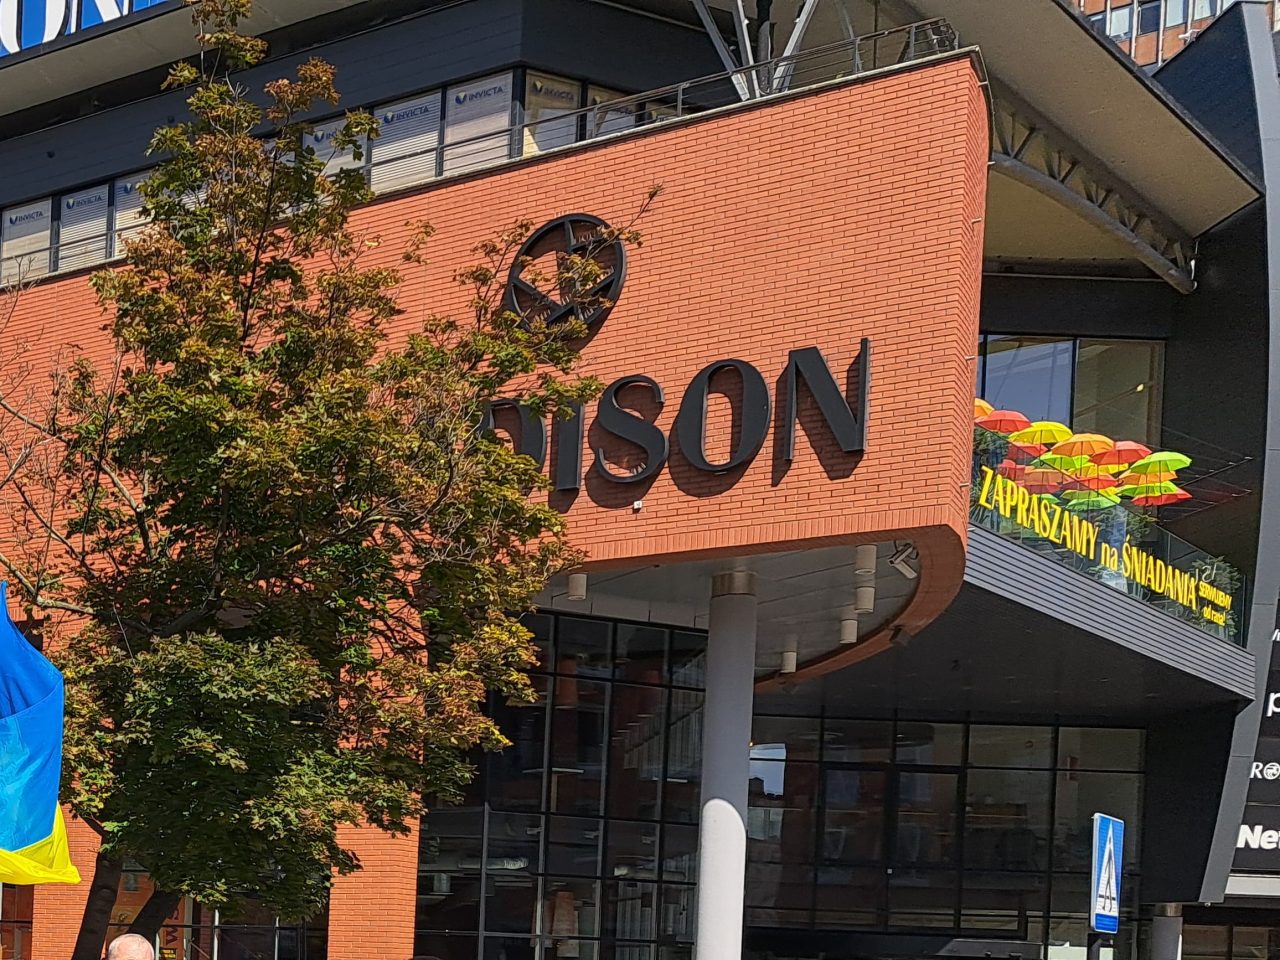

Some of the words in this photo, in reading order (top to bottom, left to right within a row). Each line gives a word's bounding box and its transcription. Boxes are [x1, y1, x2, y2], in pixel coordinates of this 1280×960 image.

[469, 86, 504, 102] INVICTA
[396, 105, 430, 121] INVICTA
[18, 210, 44, 224] INVICTA
[978, 465, 1099, 560] ZAPRASZAMY
[1100, 542, 1118, 571] na
[1121, 534, 1198, 611] ŚNIADANIA
